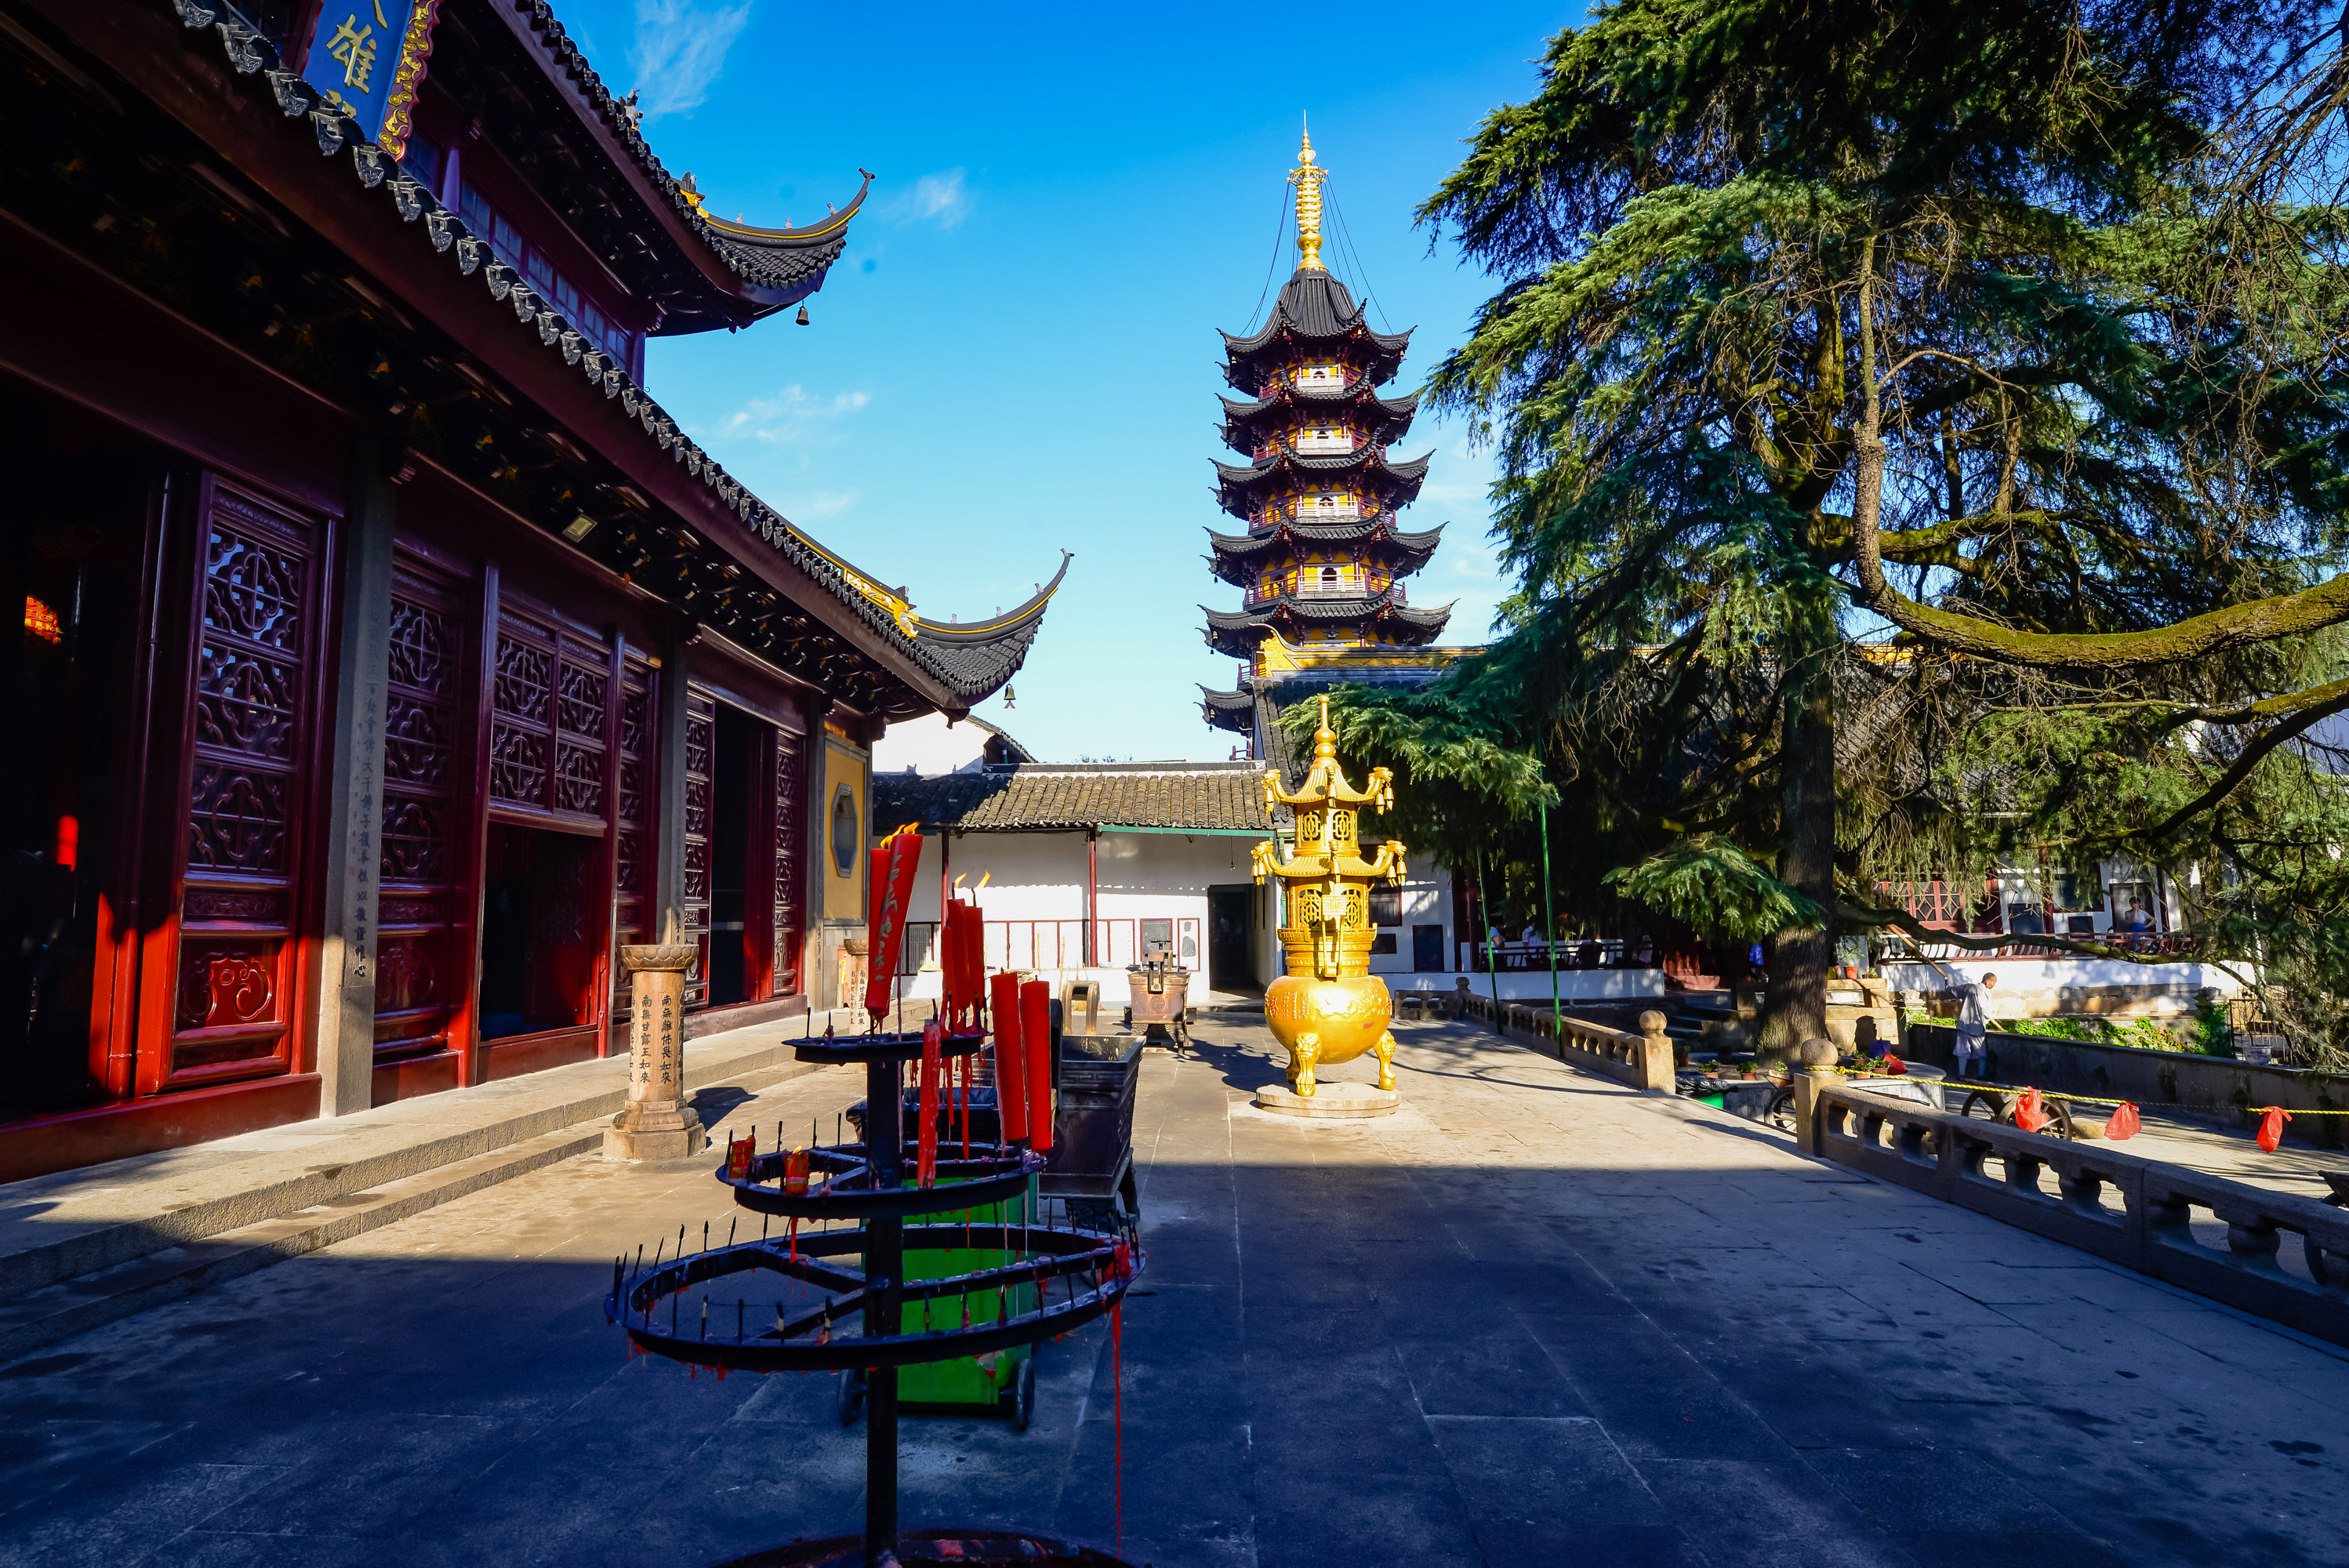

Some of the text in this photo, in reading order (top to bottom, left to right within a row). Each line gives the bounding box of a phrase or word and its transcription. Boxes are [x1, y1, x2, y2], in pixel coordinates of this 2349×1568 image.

[640, 994, 652, 1083] 南無甘露王如來
[659, 994, 672, 1084] 南無離怖畏如來
